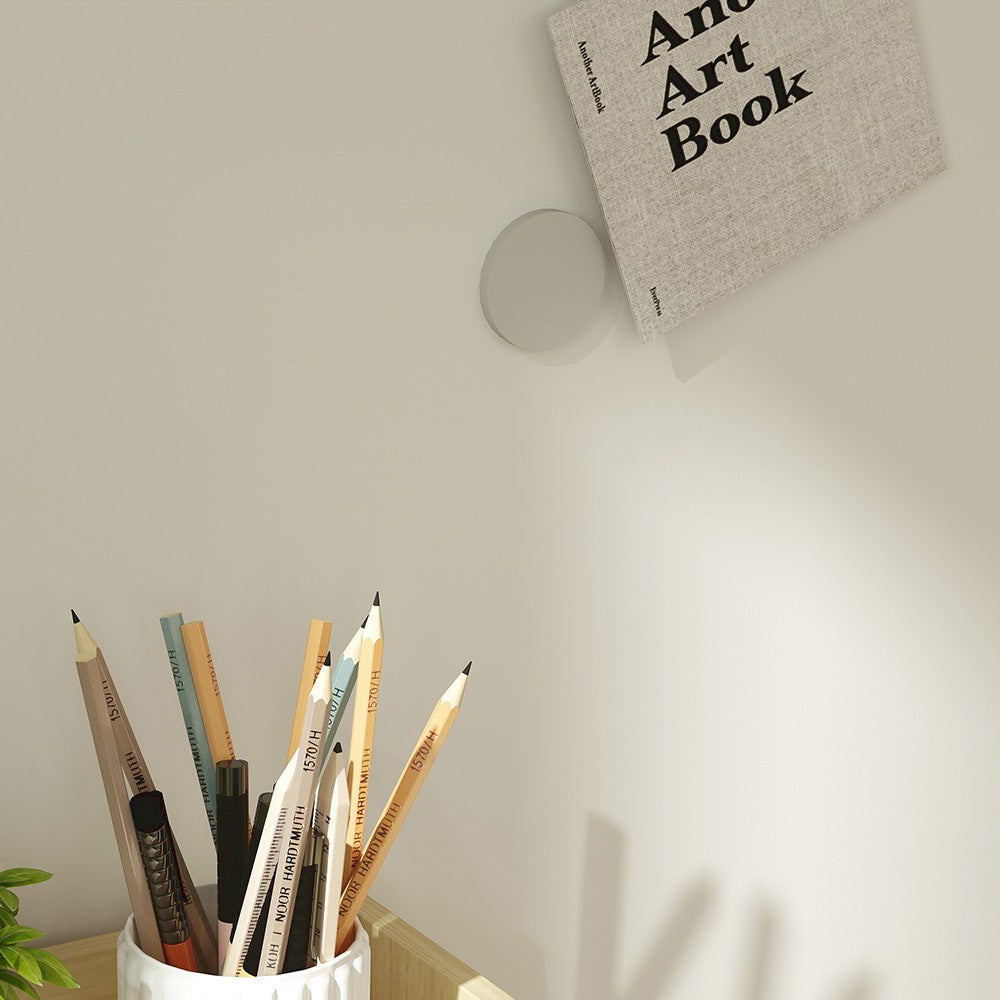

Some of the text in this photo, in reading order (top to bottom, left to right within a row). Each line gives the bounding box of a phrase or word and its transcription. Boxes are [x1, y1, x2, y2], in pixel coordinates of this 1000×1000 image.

[577, 40, 606, 114] Another ArtBook
[656, 33, 755, 120] Art
[660, 66, 815, 172] Book
[168, 650, 185, 692] 1570/H
[368, 670, 381, 713] 1570/H
[125, 751, 148, 793] TMUTH
[303, 730, 322, 772] 1570/H
[410, 730, 439, 773] 1570/H
[351, 748, 371, 868] NOOR HARDTMUTH
[266, 943, 280, 969] KOH
[275, 887, 291, 922] NOOR
[283, 806, 306, 881] HARDTMUTH
[339, 802, 400, 917] NOOR HARDTMUTH
